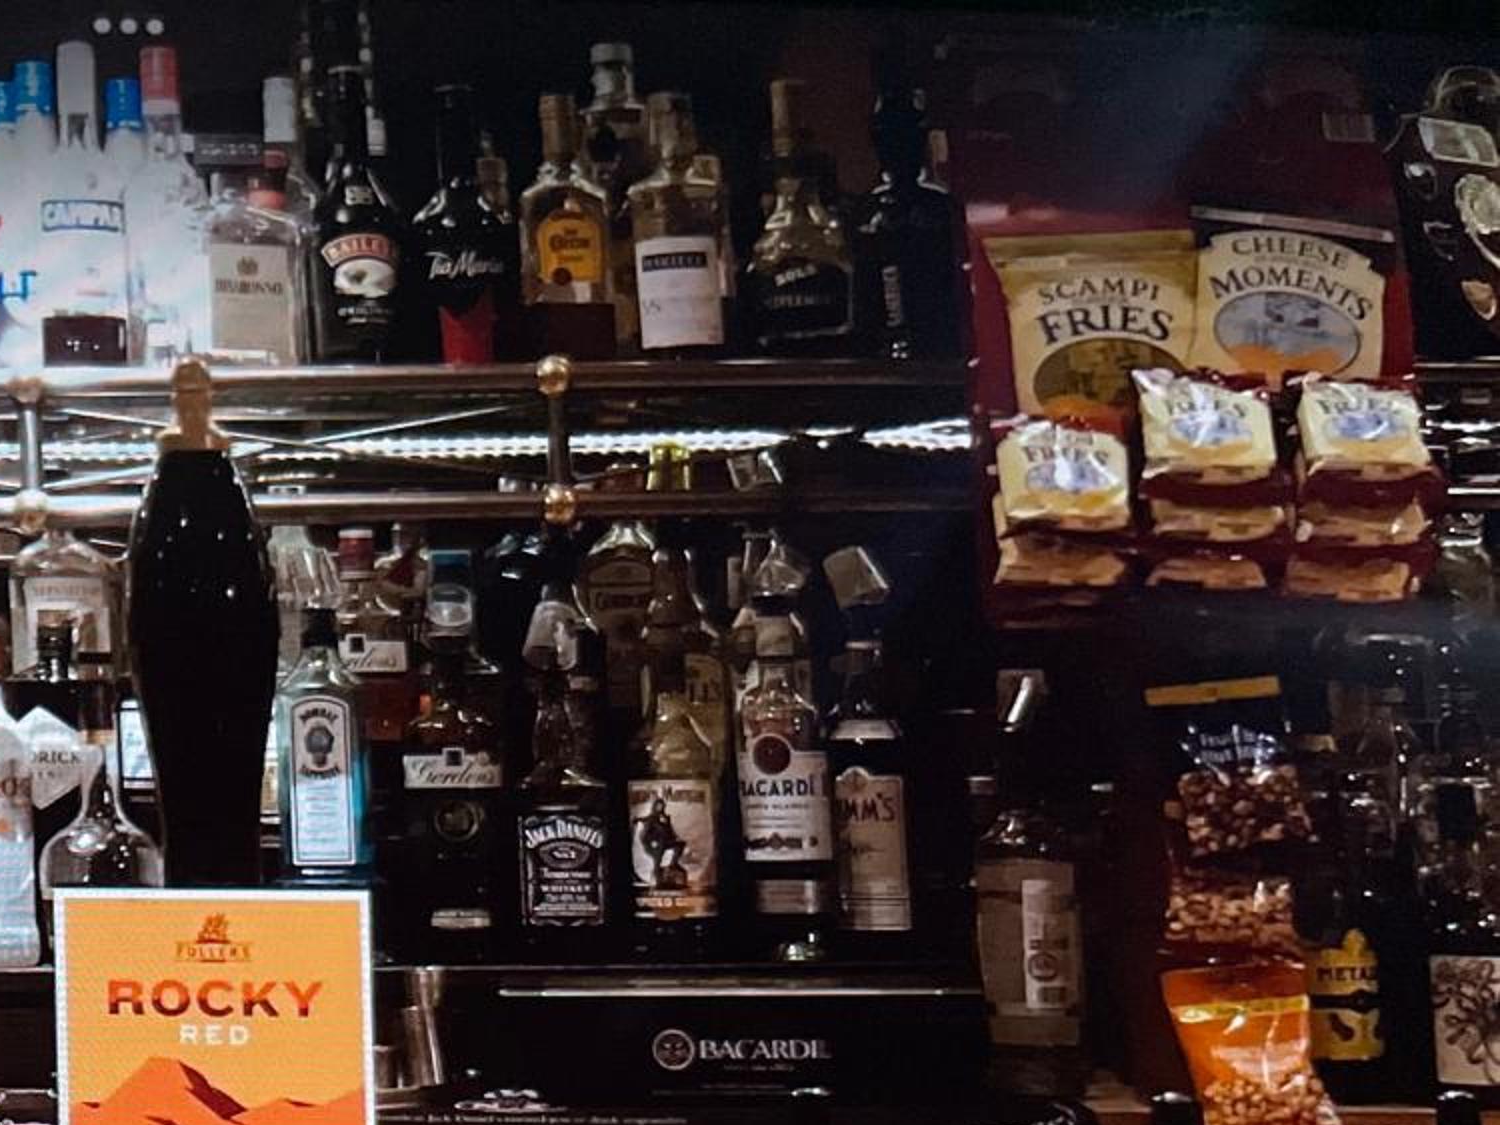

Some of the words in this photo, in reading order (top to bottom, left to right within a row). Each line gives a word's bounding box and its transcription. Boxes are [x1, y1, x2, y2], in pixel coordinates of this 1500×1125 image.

[1231, 235, 1350, 271] CHEESE
[1038, 277, 1160, 305] SCAMPI
[1208, 265, 1374, 321] MOMENTS
[1035, 304, 1174, 346] FRIES
[524, 824, 556, 849] JACK
[107, 980, 323, 1018] ROCKY
[179, 1024, 252, 1046] RED
